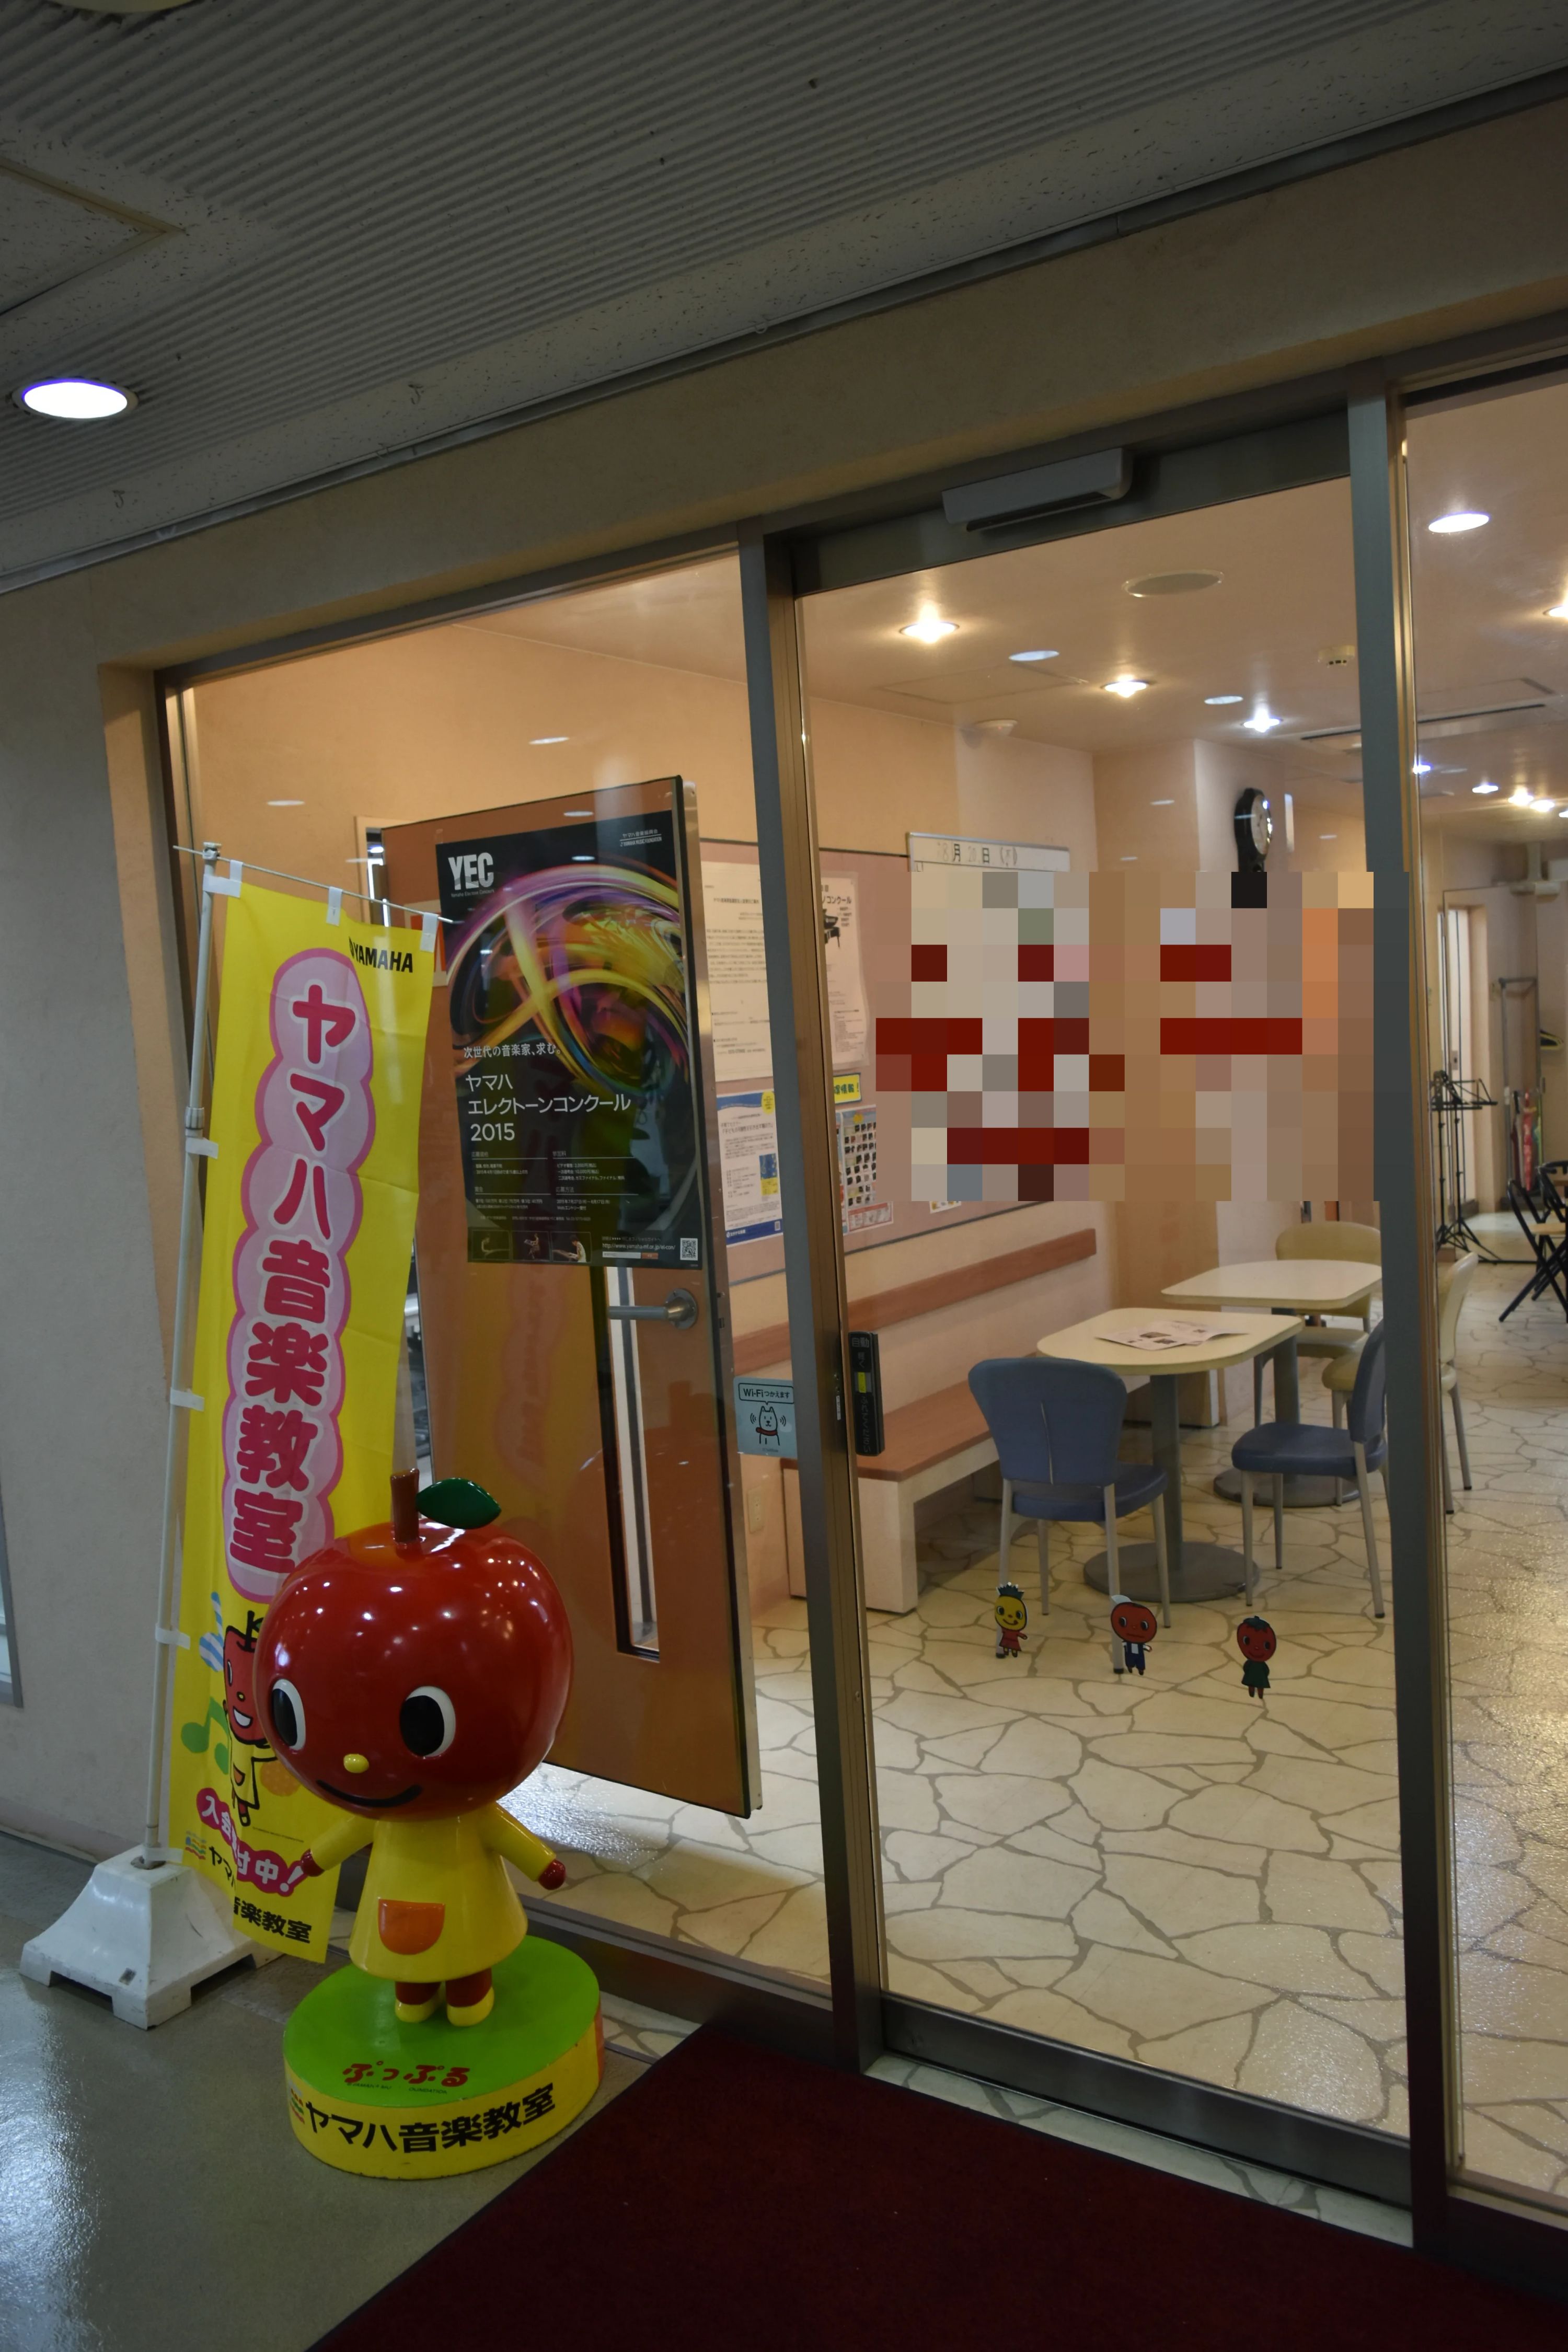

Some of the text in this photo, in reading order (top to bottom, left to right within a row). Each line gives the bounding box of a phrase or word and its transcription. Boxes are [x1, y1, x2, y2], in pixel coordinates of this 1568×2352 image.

[448, 852, 494, 891] YEC
[353, 942, 413, 973] YAMAHA
[464, 1042, 561, 1059] 次世代の音楽家、求む。
[465, 1073, 513, 1092] ヤマハ
[468, 1093, 631, 1115] エレクトーンコンクール
[470, 1123, 515, 1142] 2015
[230, 984, 356, 1574] ヤマハ音楽教室
[342, 2061, 470, 2087] ぷっぷる
[306, 2082, 555, 2153] ヤマハ音楽教室
